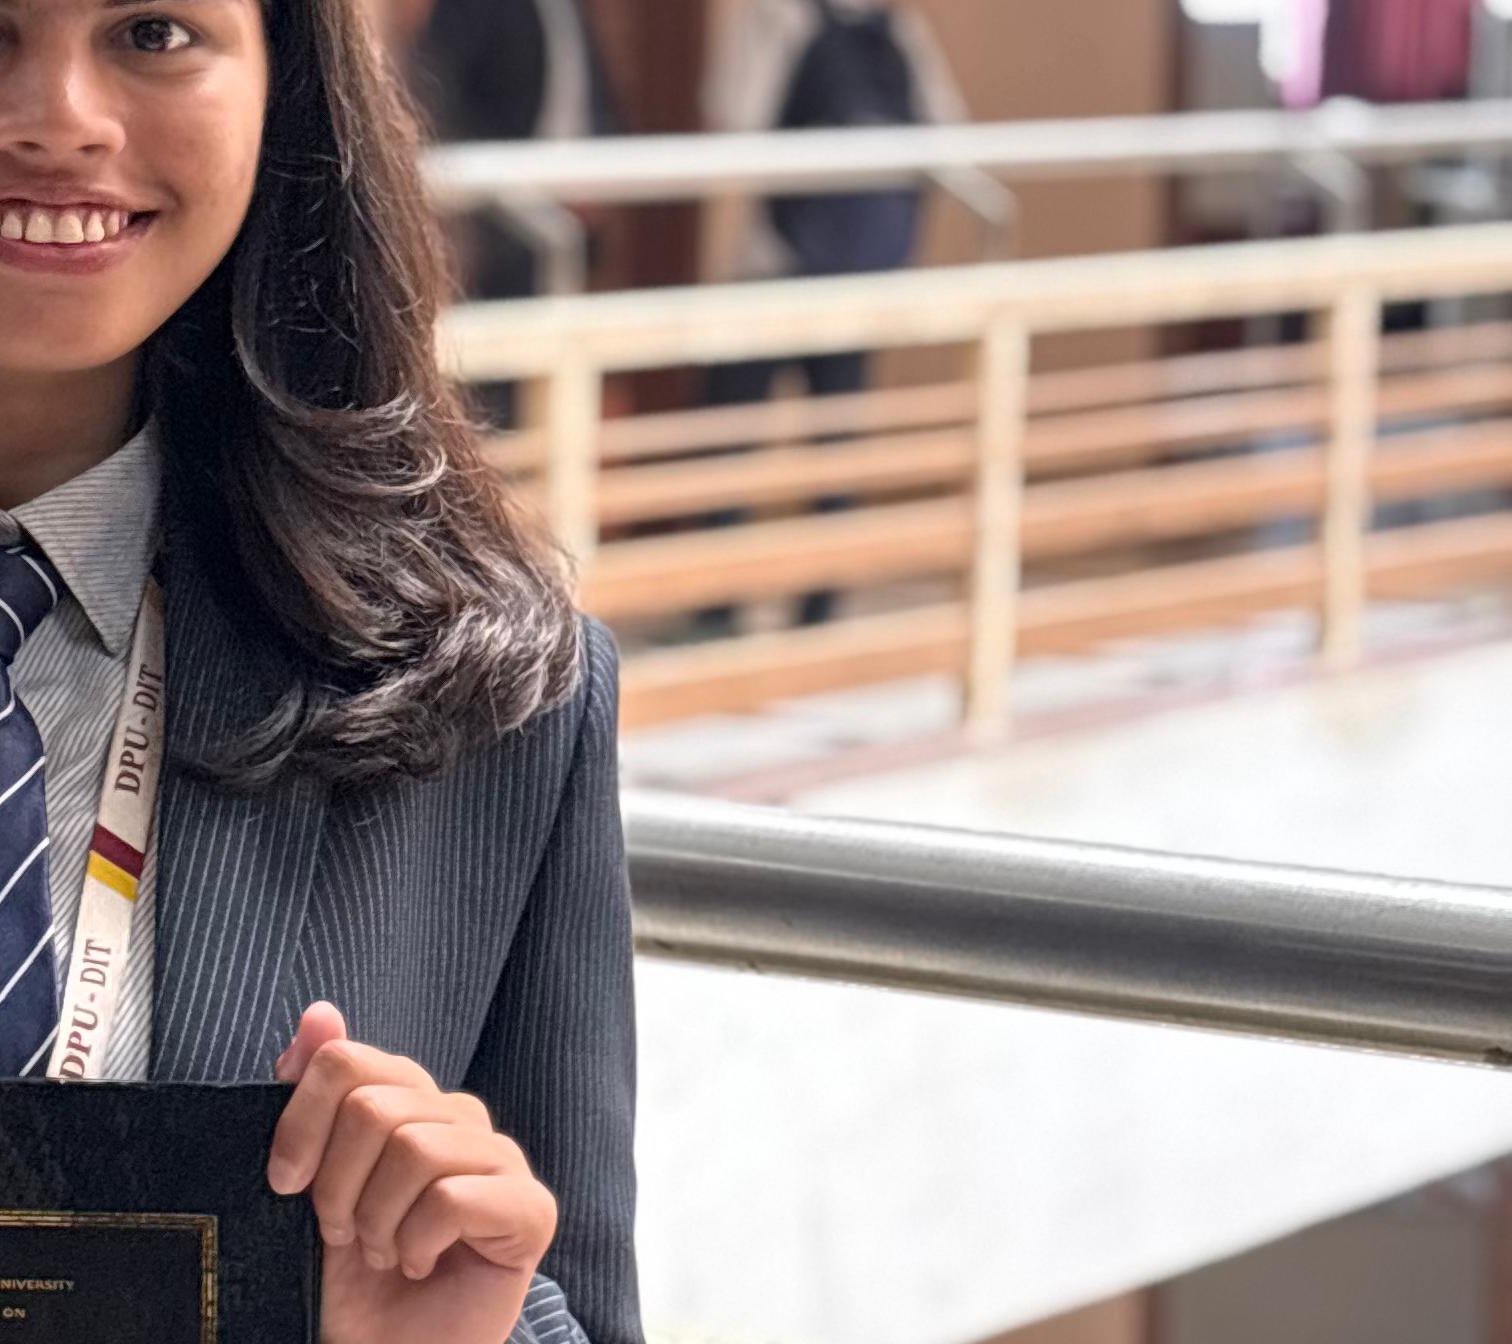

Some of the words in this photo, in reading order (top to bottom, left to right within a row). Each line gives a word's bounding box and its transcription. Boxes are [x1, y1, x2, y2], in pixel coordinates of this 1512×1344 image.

[114, 726, 149, 796] DPU
[133, 663, 163, 712] DIT
[59, 1004, 98, 1079] DPU
[80, 939, 111, 987] DIT
[2, 1307, 26, 1319] ON
